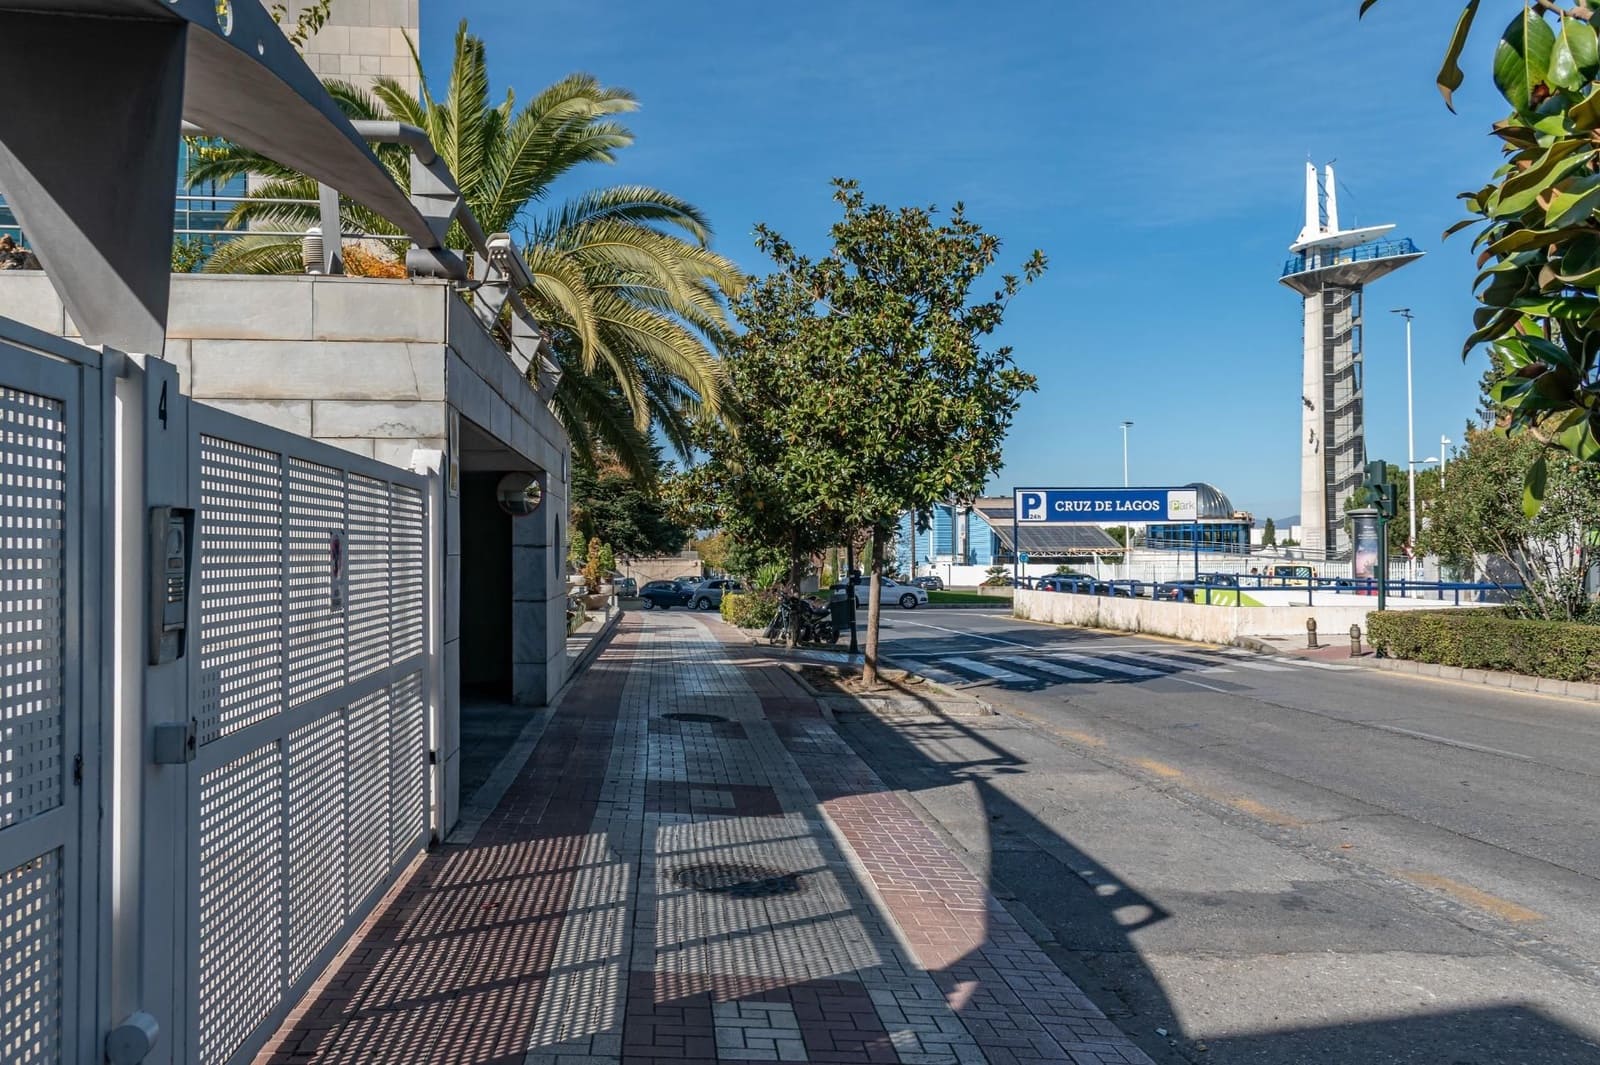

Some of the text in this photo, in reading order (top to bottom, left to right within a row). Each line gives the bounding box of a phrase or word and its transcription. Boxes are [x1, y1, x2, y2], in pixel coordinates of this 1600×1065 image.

[159, 380, 167, 430] 4
[1022, 493, 1041, 519] P
[1055, 500, 1160, 511] CRUZ DE LAGOS
